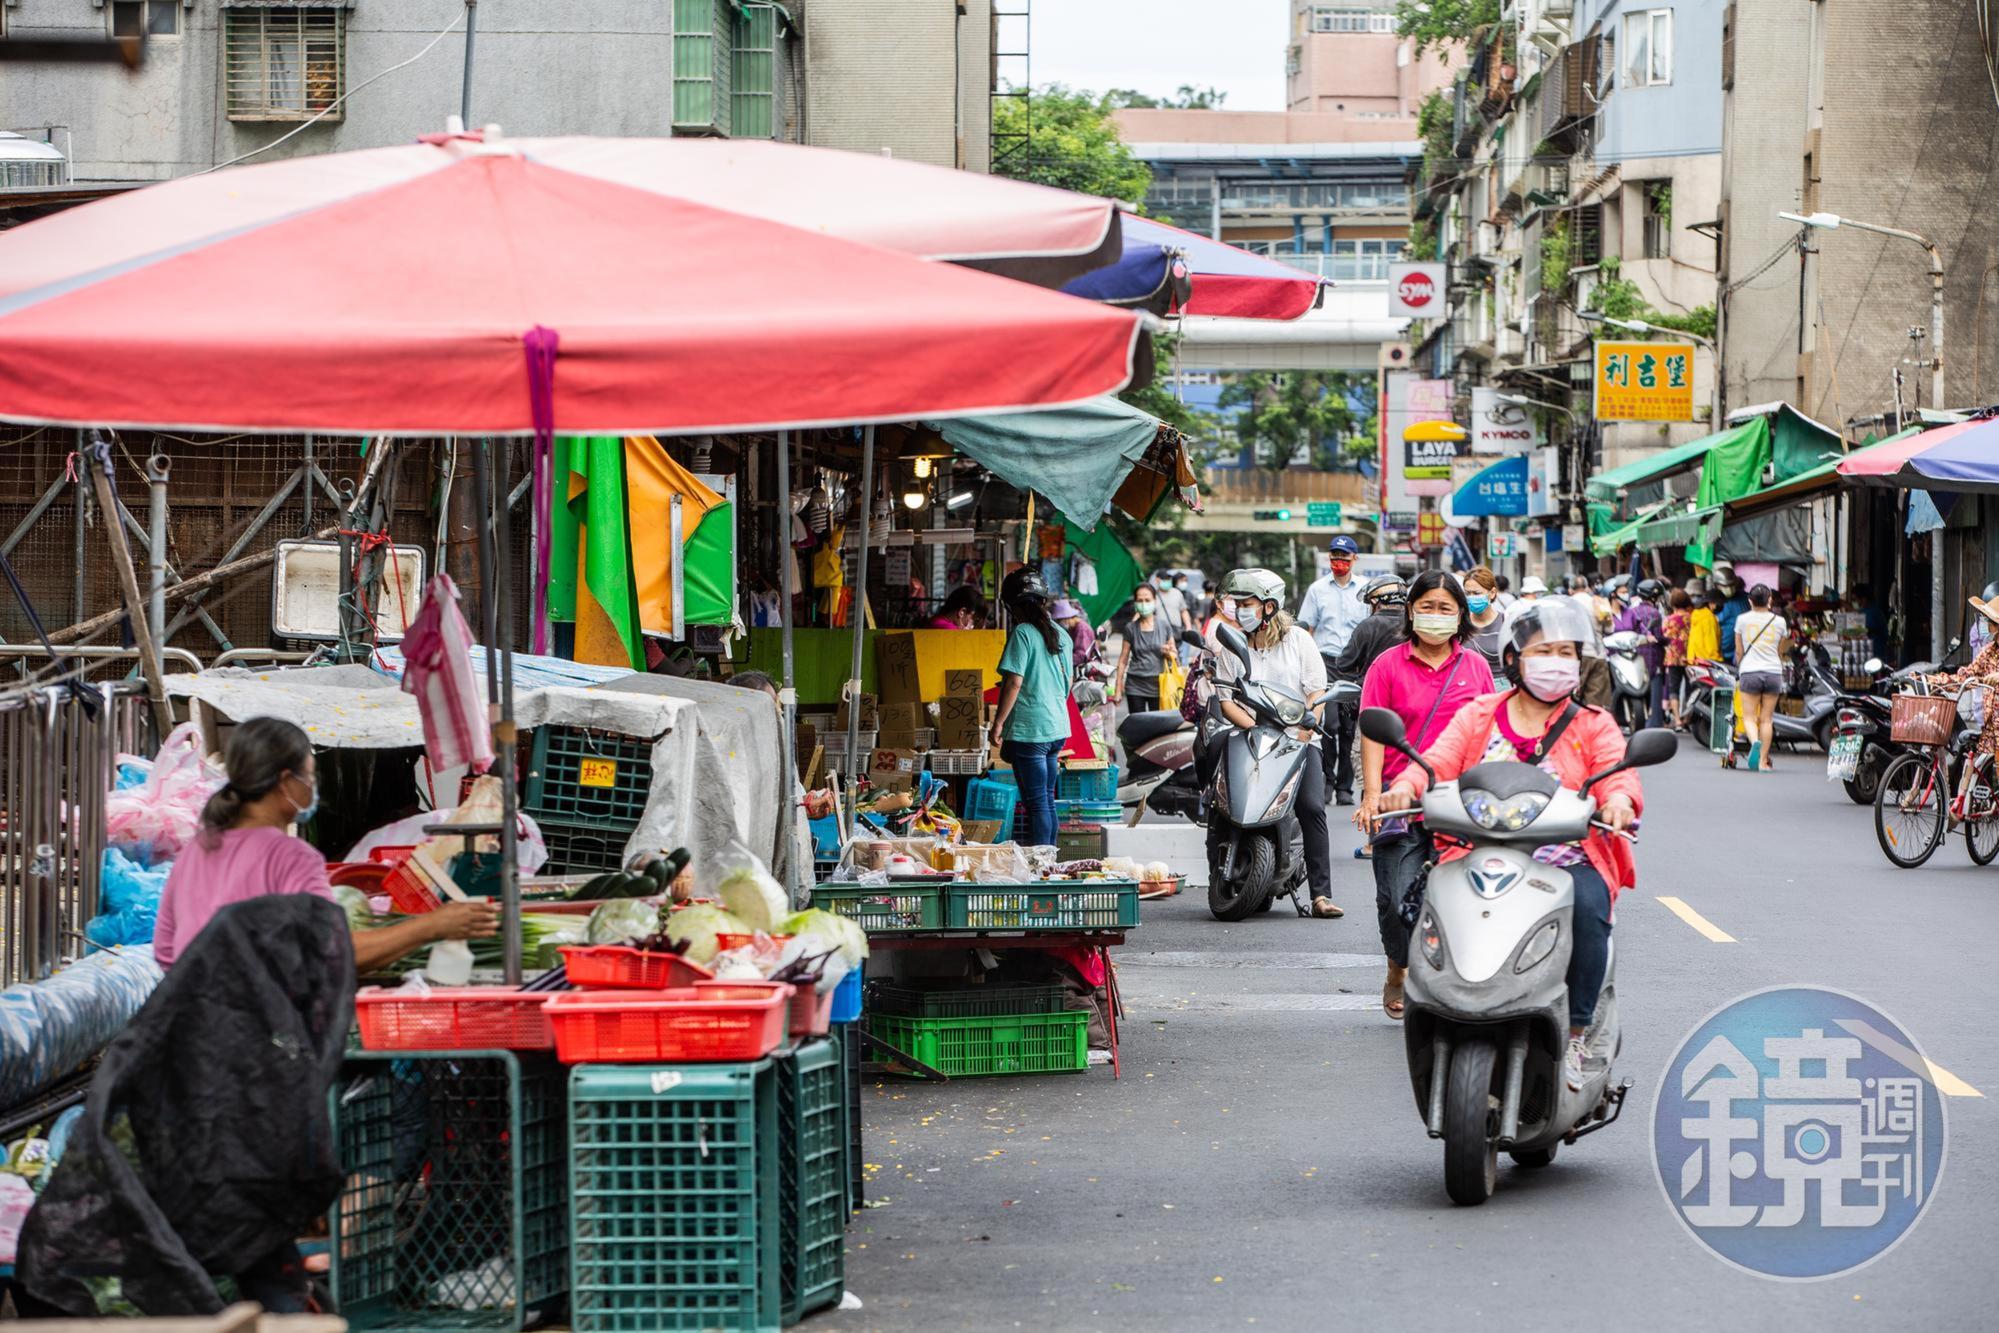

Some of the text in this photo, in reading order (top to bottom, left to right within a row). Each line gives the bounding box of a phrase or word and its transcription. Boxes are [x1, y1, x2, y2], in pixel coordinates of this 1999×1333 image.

[1398, 282, 1435, 301] SYM
[1604, 353, 1687, 389] 利吉堡
[1481, 430, 1531, 441] KYMCO
[1412, 441, 1458, 456] LAYA
[1412, 455, 1451, 466] BURGE
